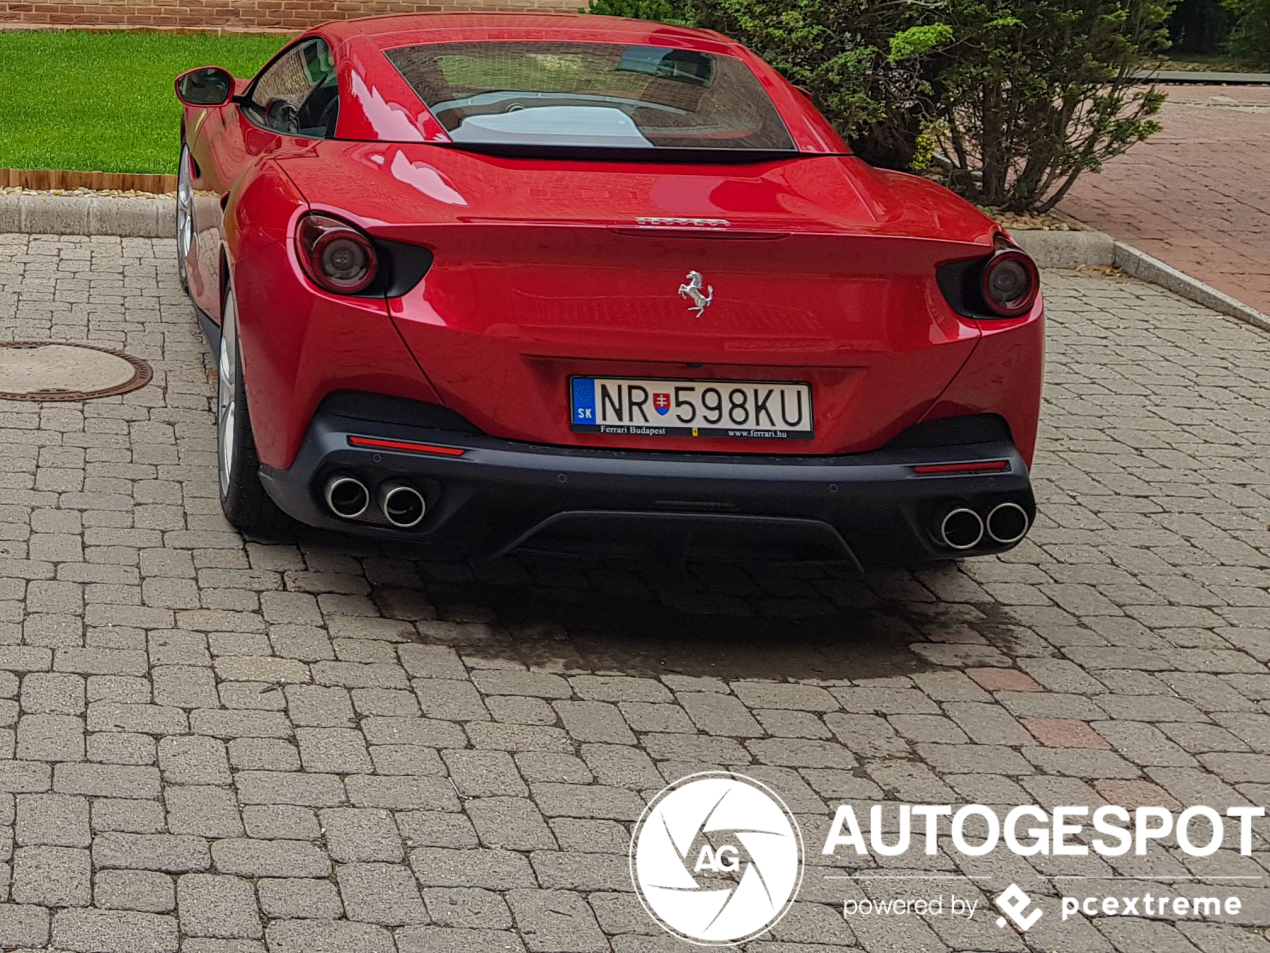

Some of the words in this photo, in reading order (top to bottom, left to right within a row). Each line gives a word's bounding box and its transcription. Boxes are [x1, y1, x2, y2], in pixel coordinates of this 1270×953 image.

[600, 383, 650, 423] NR
[673, 386, 802, 427] 598KU
[577, 408, 592, 418] SK
[600, 425, 628, 433] Ferrari
[629, 426, 666, 435] Budapest
[728, 430, 787, 438] www.ferrari.hu
